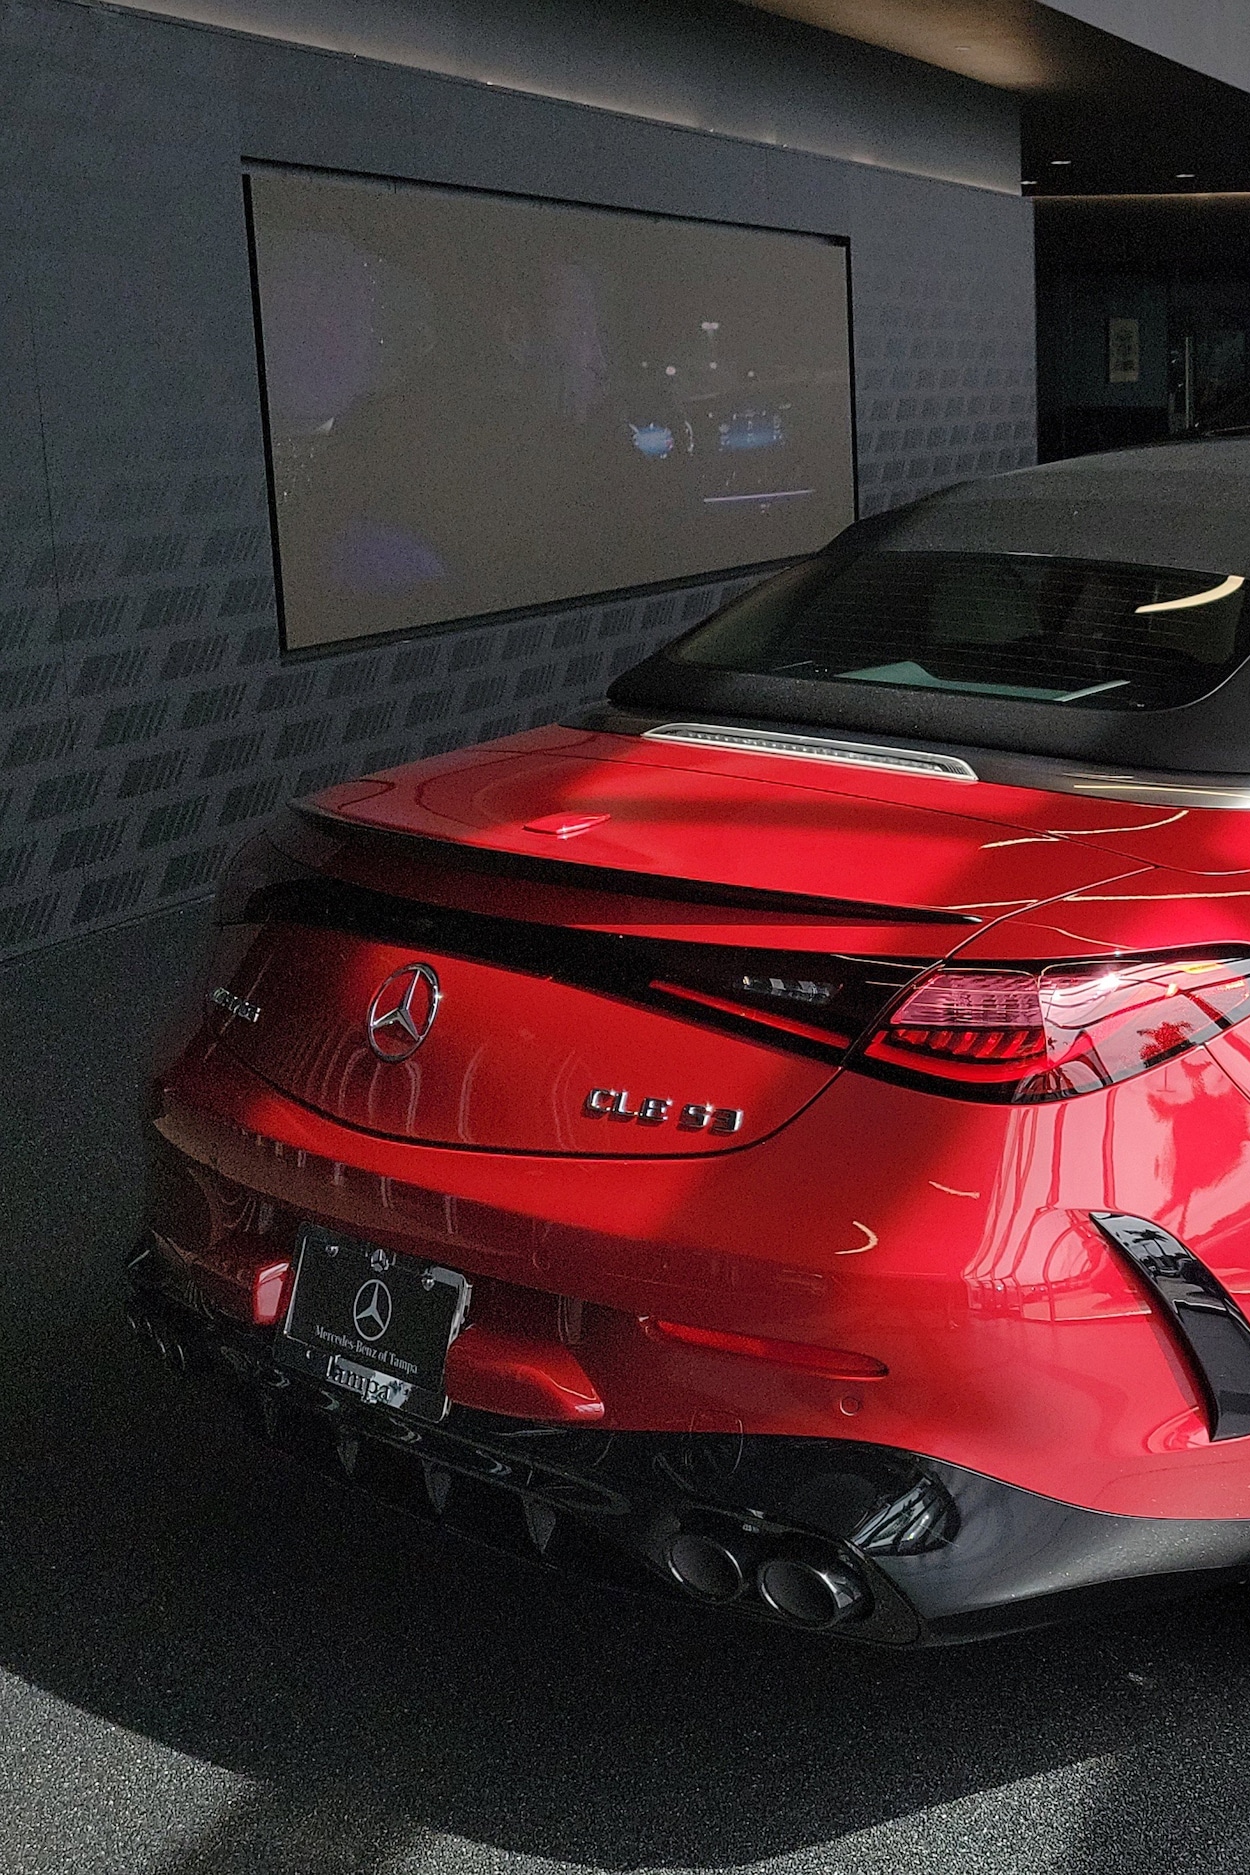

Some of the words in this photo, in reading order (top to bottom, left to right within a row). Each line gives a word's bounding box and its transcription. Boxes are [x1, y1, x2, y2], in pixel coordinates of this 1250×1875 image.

[588, 1088, 673, 1122] CLE
[680, 1102, 744, 1132] 53
[314, 1324, 377, 1359] Mercedes-Benz
[378, 1350, 388, 1363] of
[389, 1351, 418, 1375] Tampa
